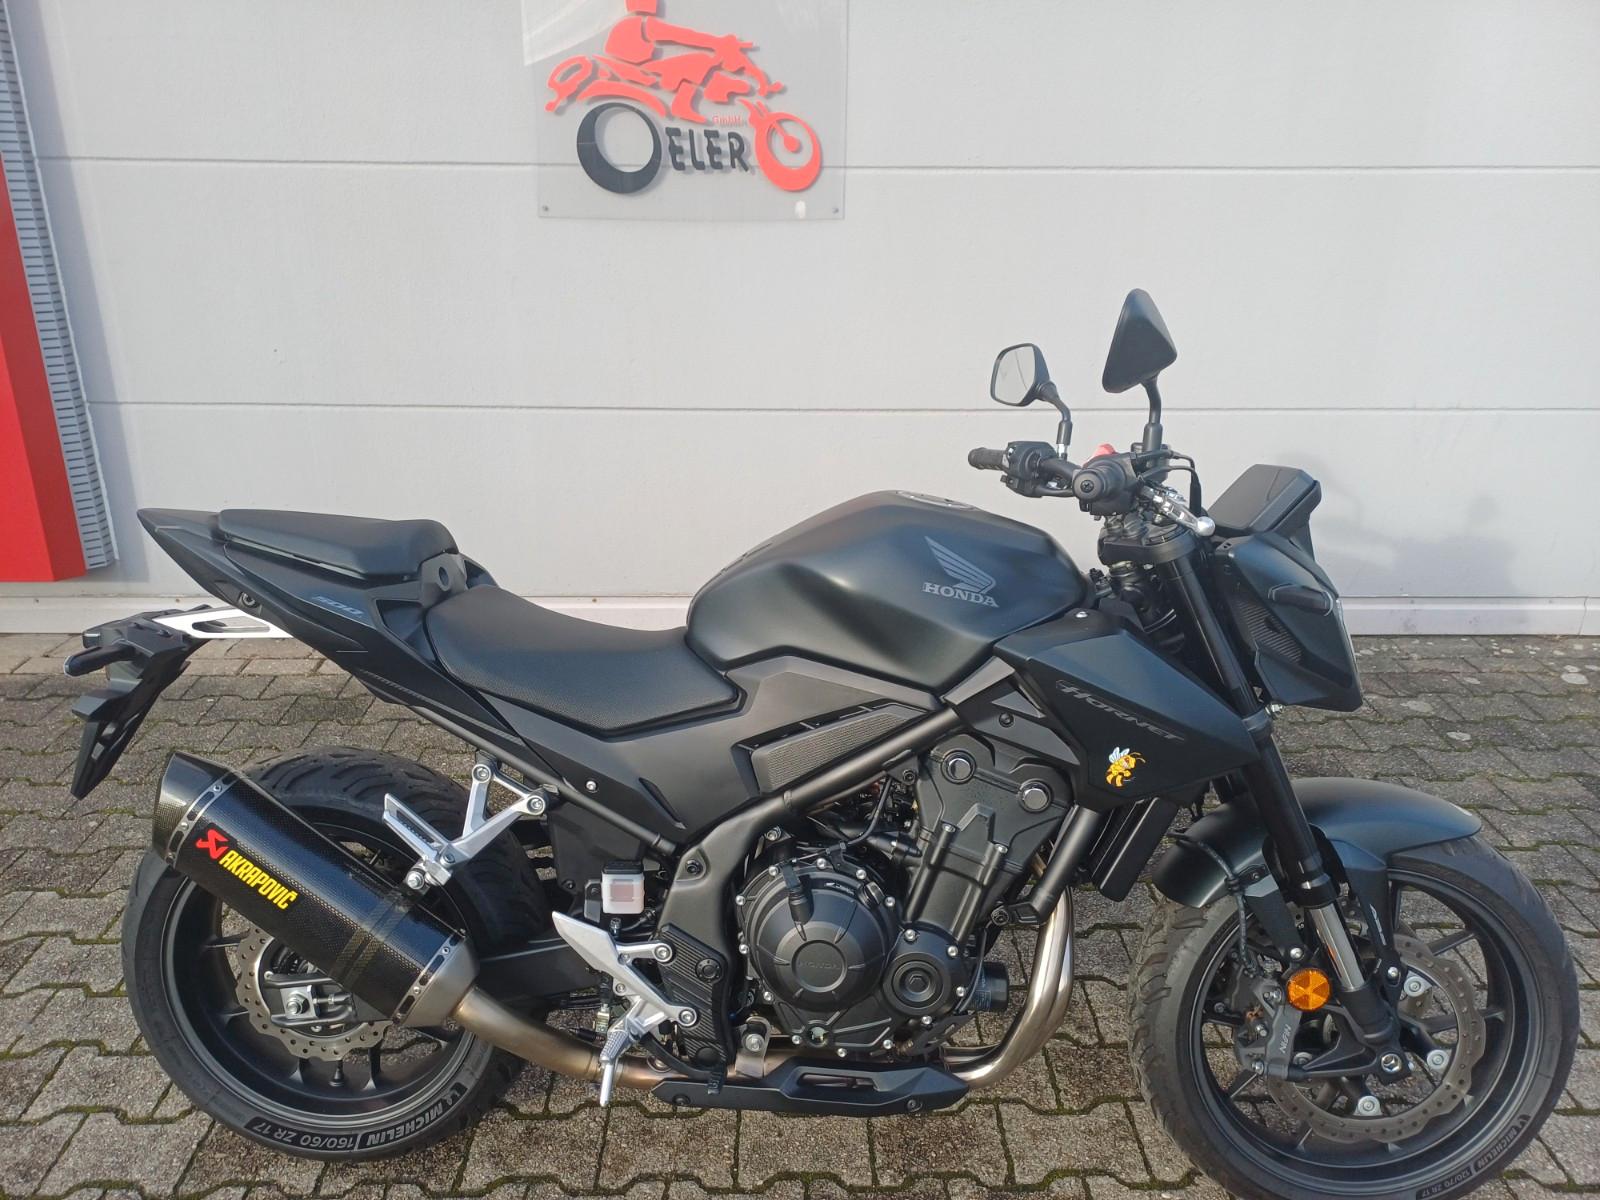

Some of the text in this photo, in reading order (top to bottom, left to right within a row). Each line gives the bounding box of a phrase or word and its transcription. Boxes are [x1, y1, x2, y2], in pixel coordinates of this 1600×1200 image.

[922, 582, 999, 608] HONDA
[1056, 680, 1184, 741] HORNET
[253, 1104, 443, 1149] MICHELIN 160/60 ZR 17
[1478, 1127, 1518, 1168] MICHELIN
